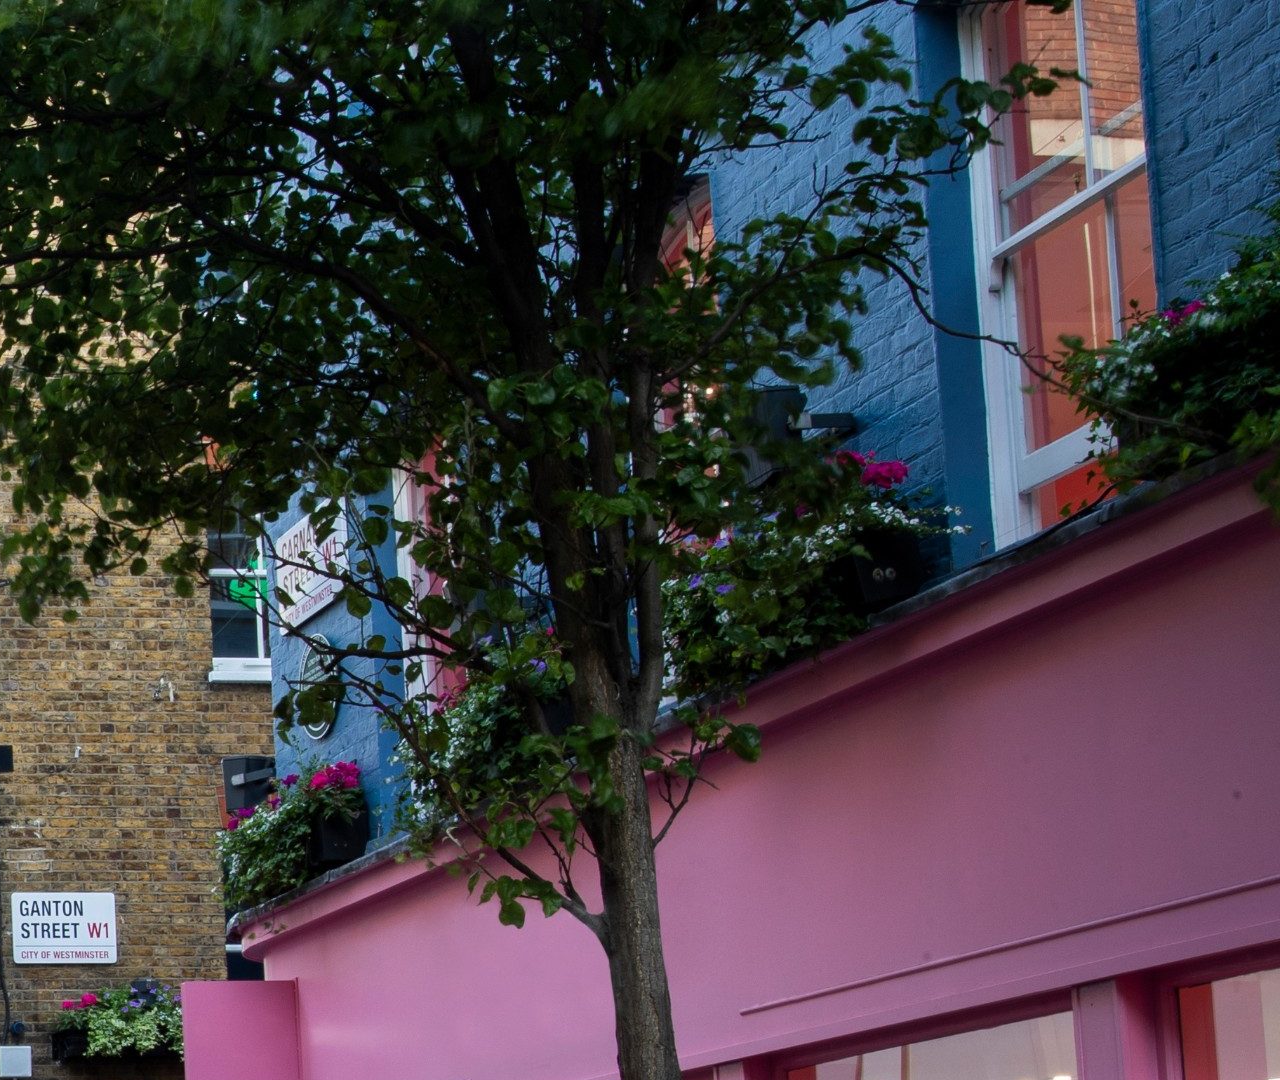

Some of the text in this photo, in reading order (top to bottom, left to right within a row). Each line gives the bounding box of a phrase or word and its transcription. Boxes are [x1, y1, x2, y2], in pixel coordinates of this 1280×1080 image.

[281, 522, 317, 561] CARNA
[321, 536, 338, 566] W1
[19, 899, 83, 917] GANTON
[20, 922, 110, 939] STREET W1
[21, 949, 109, 959] CITY OF WESTMINSTER
